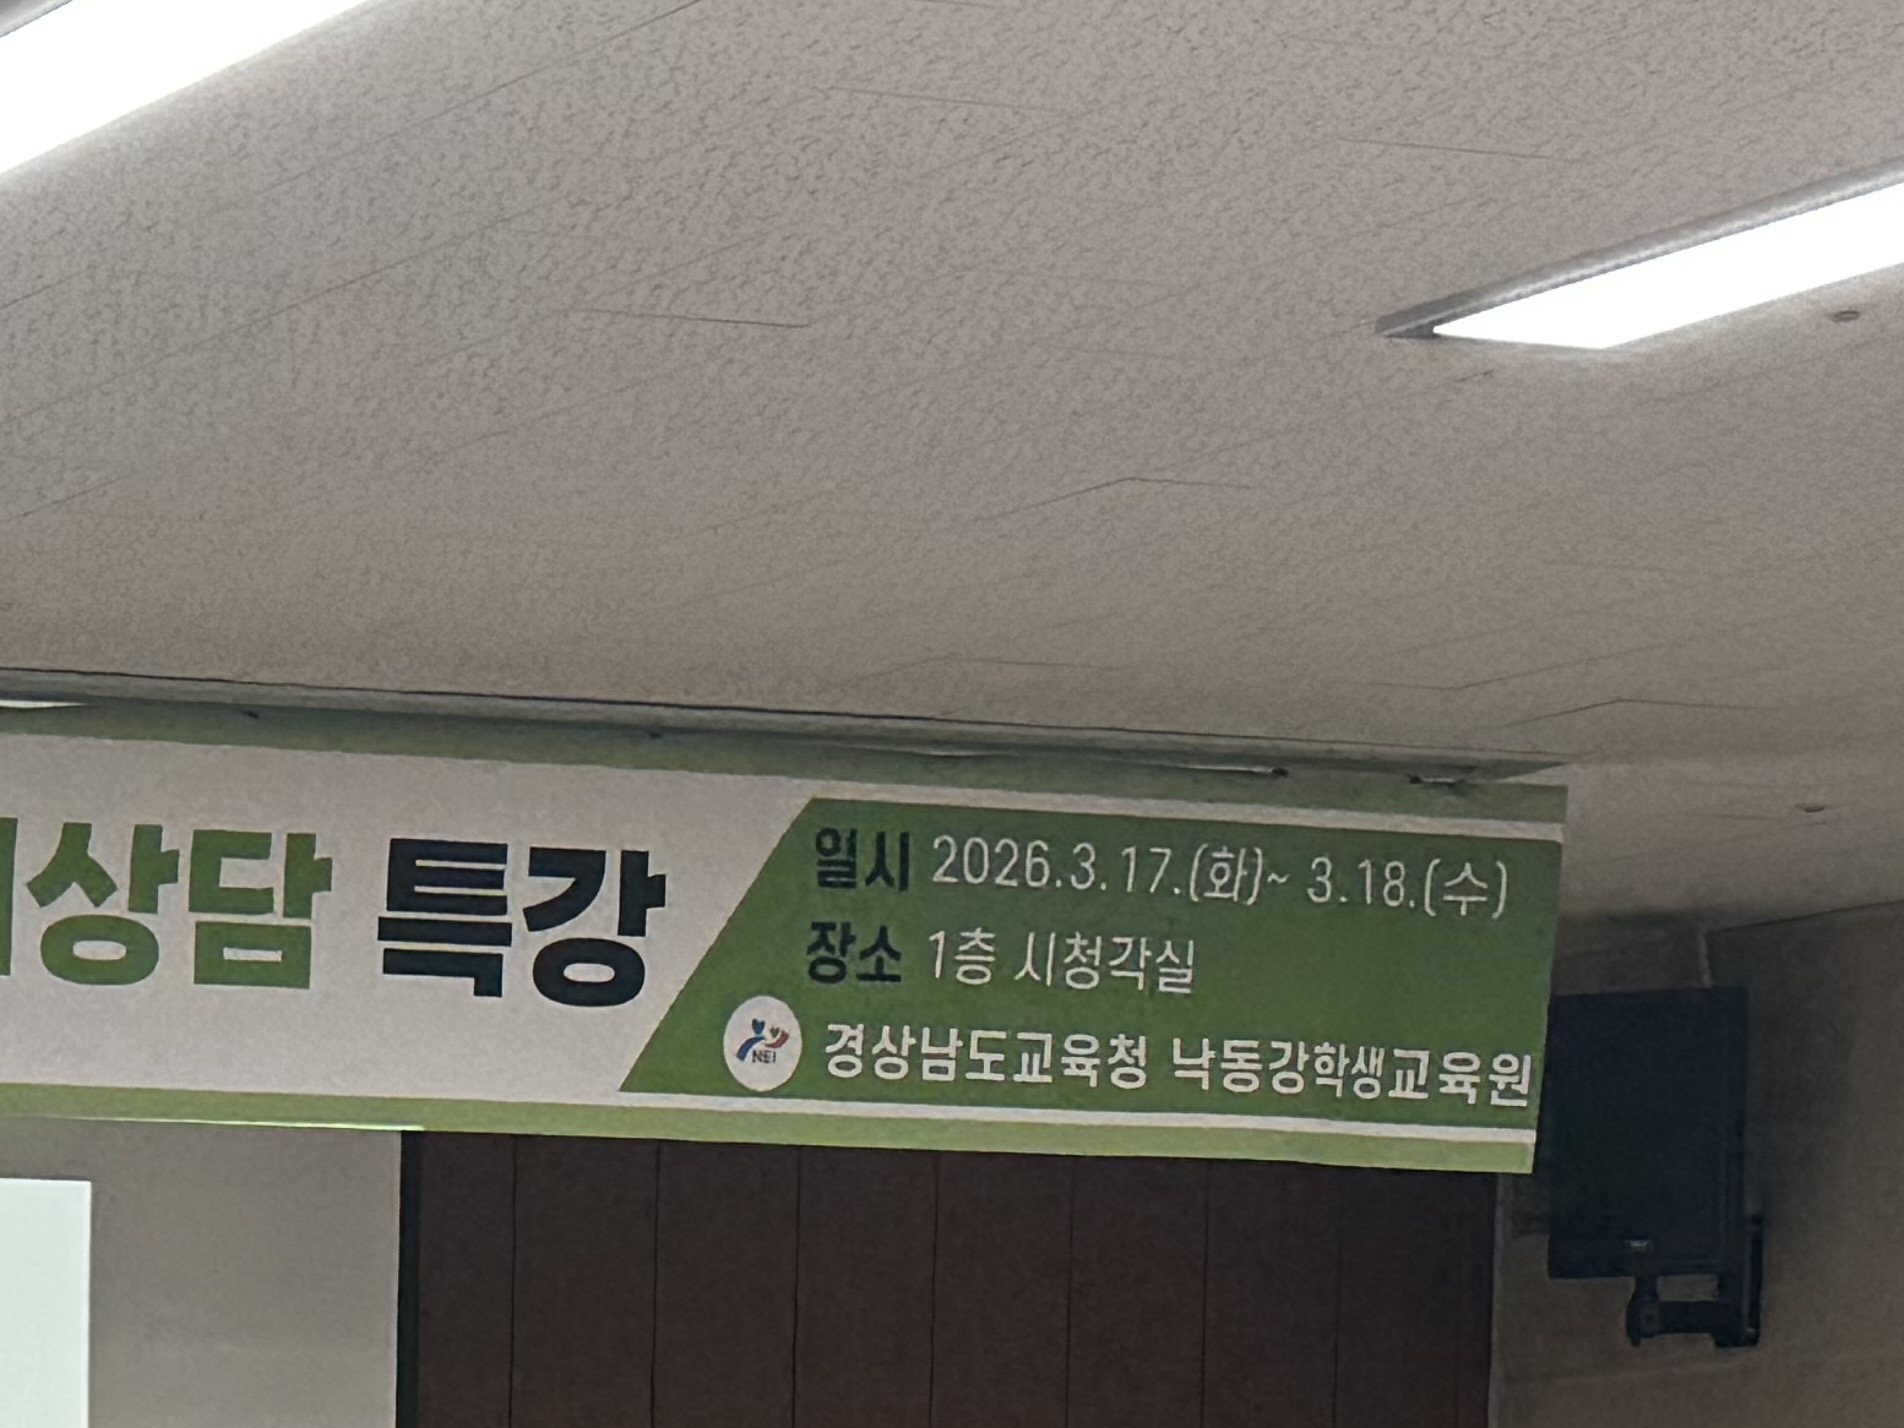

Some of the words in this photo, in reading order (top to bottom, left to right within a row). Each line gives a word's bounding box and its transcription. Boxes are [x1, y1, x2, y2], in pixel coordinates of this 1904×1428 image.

[816, 828, 909, 891] 일시
[1308, 857, 1507, 918] 3.18.(수)
[377, 838, 668, 1007] 특강
[807, 922, 901, 983] 장소
[929, 927, 995, 985] 1층
[1014, 932, 1193, 993] 시청각실
[752, 1049, 777, 1064] NEI
[825, 1024, 1147, 1089] 경상남도교육청
[1173, 1038, 1532, 1107] 낙동강학생교육원
